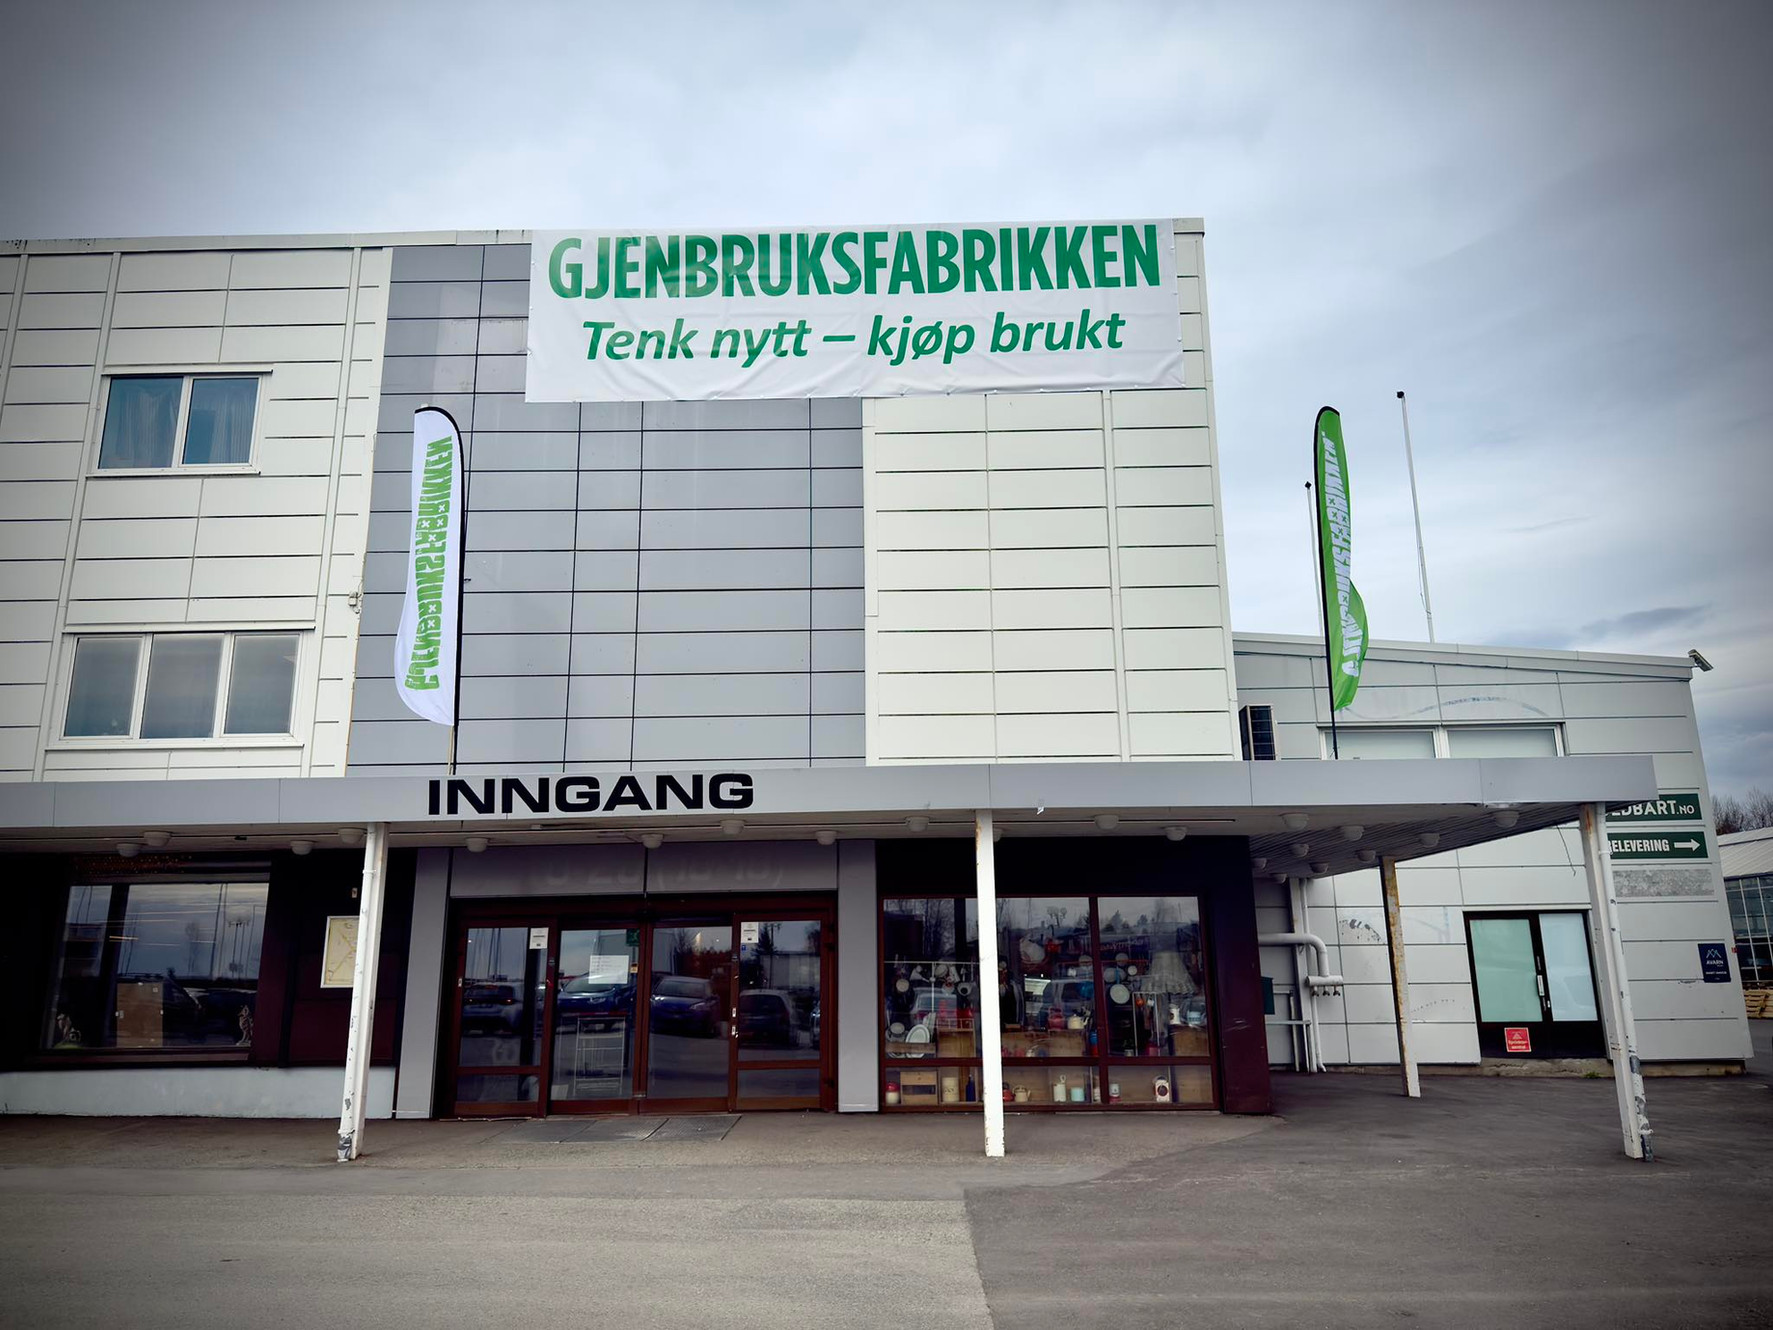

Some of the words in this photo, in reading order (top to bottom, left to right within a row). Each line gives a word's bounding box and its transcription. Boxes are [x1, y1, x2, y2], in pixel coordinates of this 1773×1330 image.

[548, 224, 1162, 300] GJENBRUKSFABRIKKEN
[582, 318, 699, 361] Tenk
[710, 320, 813, 368] nytt
[866, 314, 977, 367] kjøp
[990, 308, 1127, 354] brukt
[428, 773, 754, 816] INNGANG
